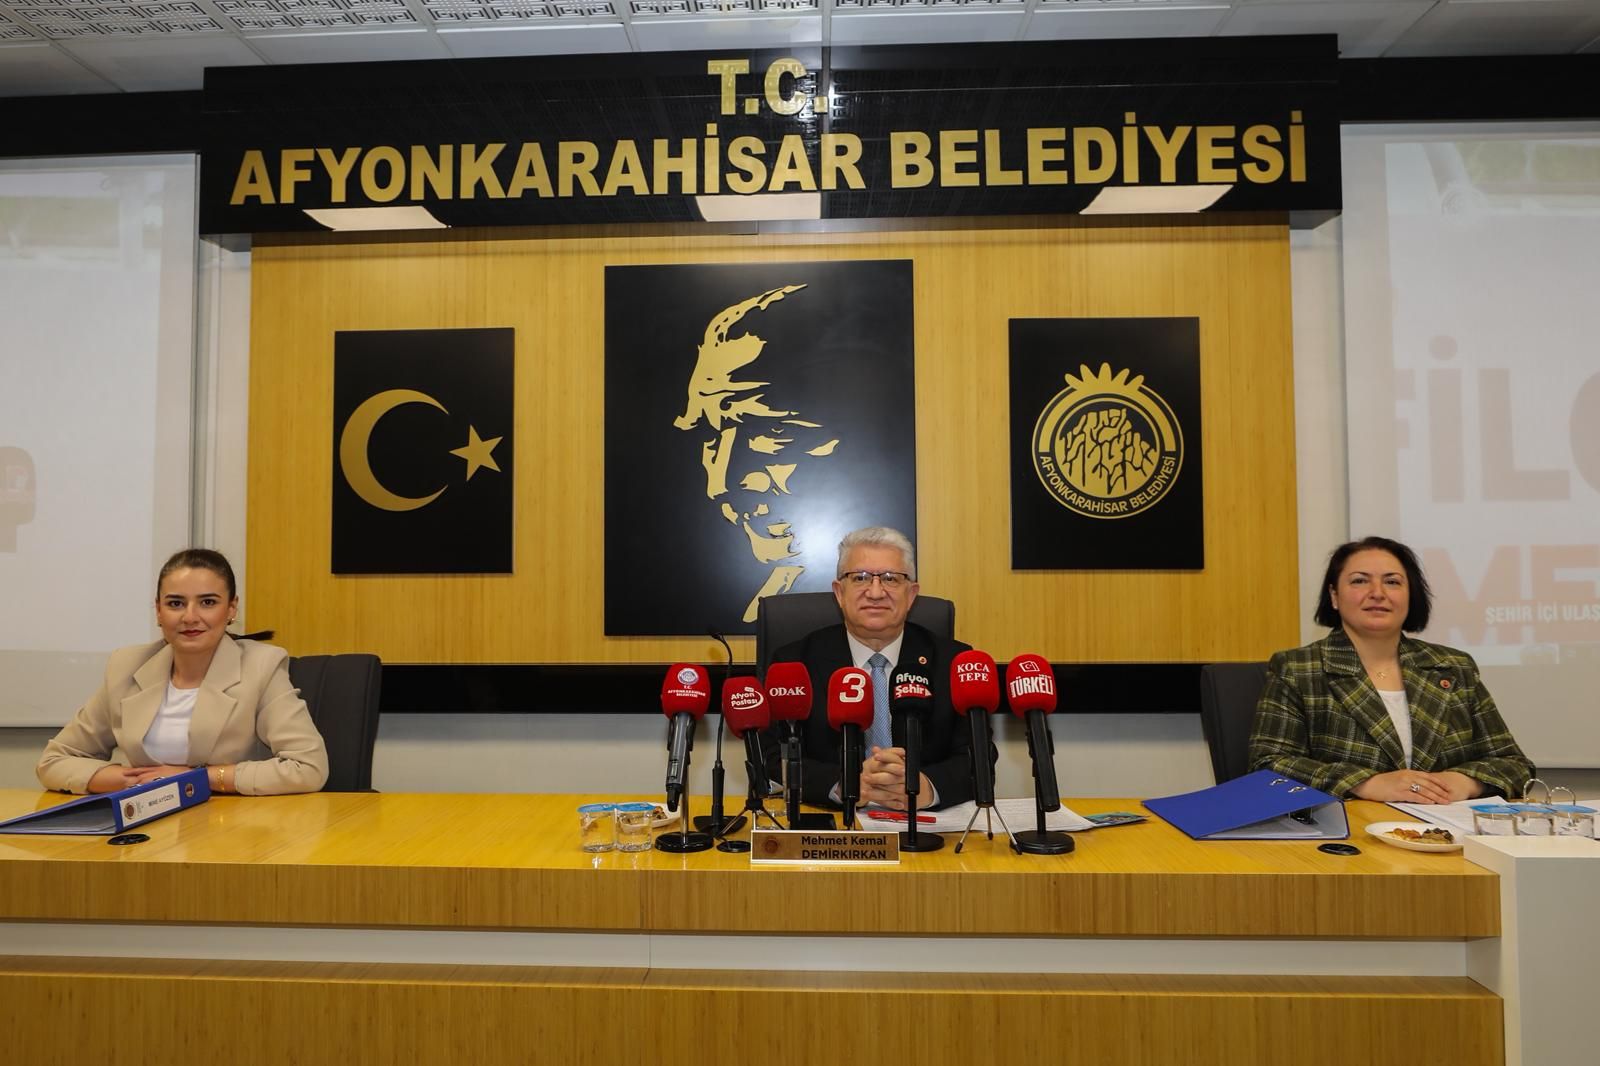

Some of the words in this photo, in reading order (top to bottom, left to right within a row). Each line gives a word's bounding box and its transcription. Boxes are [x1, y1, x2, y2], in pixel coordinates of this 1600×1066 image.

[707, 57, 828, 115] T.C.
[229, 122, 867, 205] AFYONKARAHİSAR
[890, 110, 1307, 188] BELEDİYESİ
[1040, 456, 1129, 513] AFYONKARAHİSAR
[1129, 456, 1176, 508] BELEDİYESİ
[1486, 603, 1532, 624] ŞEHİR
[1537, 601, 1557, 623] İÇİ
[957, 662, 990, 673] KOCA
[896, 672, 929, 685] Afyon
[958, 672, 989, 683] TEPE
[769, 687, 806, 697] ODAK
[839, 673, 866, 702] 3
[731, 692, 755, 700] Afyon
[731, 699, 758, 707] Postası
[802, 836, 847, 846] Mehmet
[851, 836, 887, 846] Kemal
[802, 848, 887, 859] DEMİRKIRKAN
